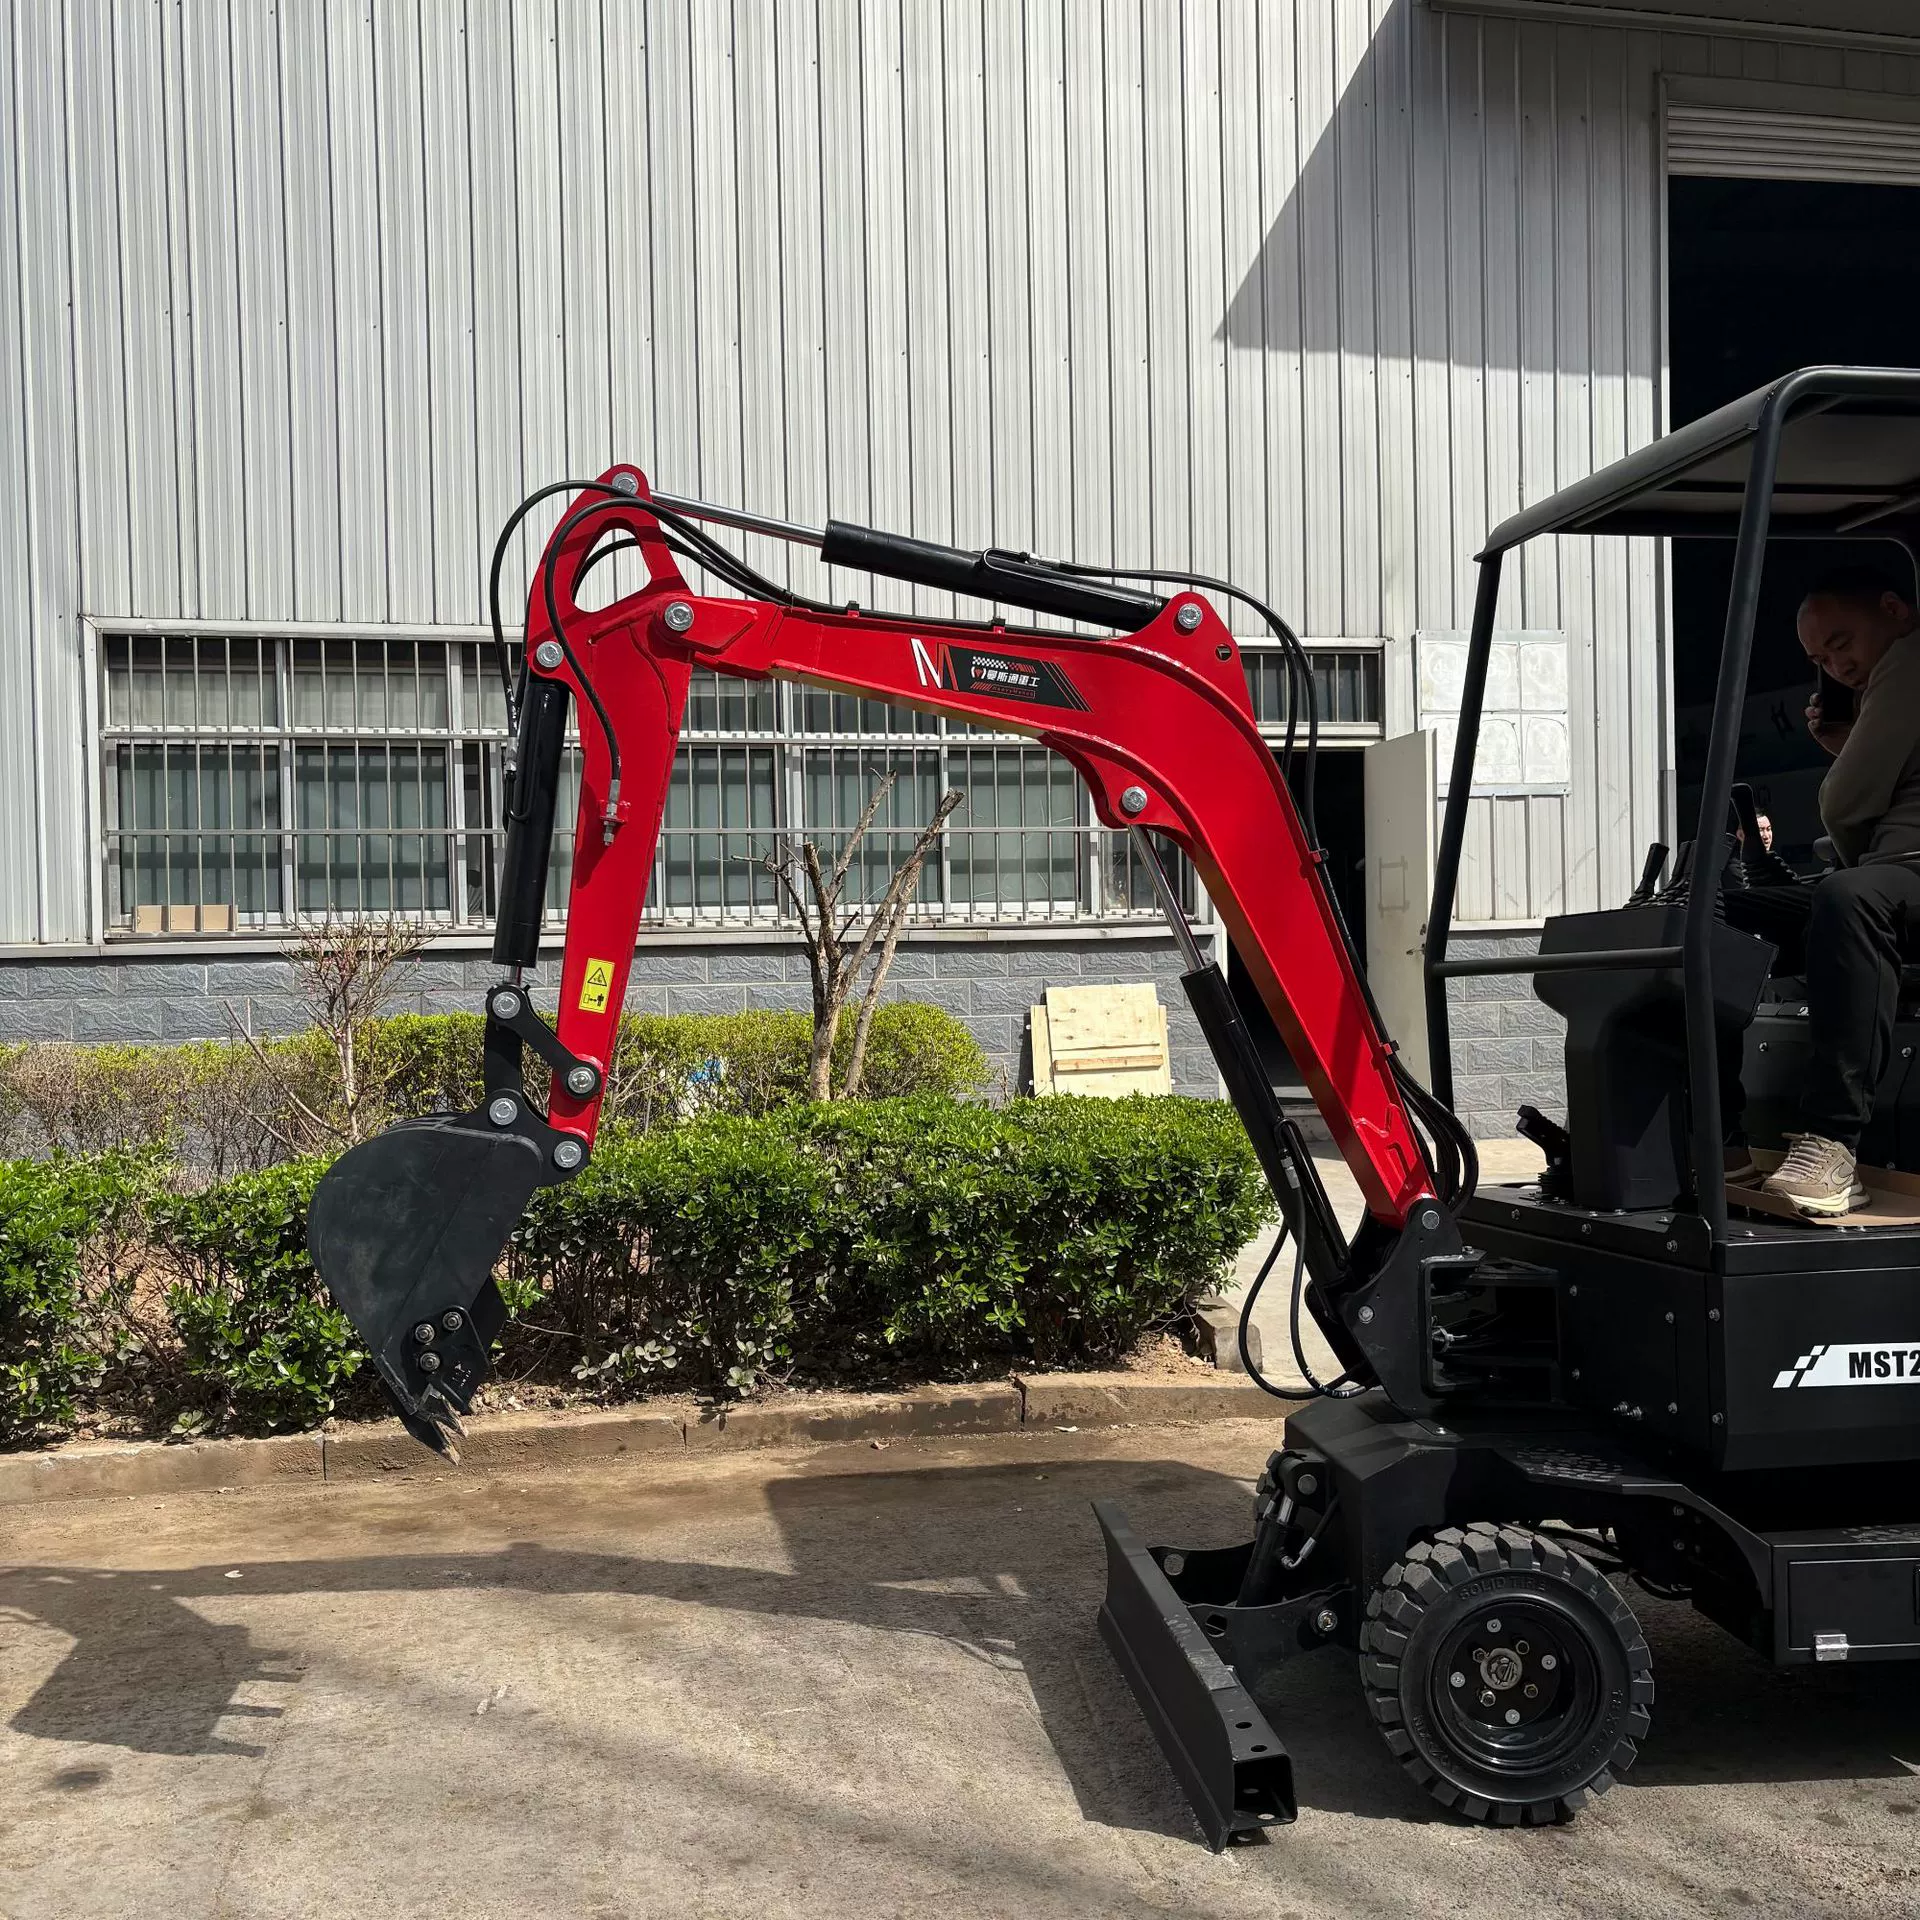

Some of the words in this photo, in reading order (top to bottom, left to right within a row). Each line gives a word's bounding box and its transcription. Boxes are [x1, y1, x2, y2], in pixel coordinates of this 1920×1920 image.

[1848, 1350, 1920, 1378] MST2
[1459, 1576, 1505, 1600] SOLID
[1509, 1575, 1546, 1591] TIRE
